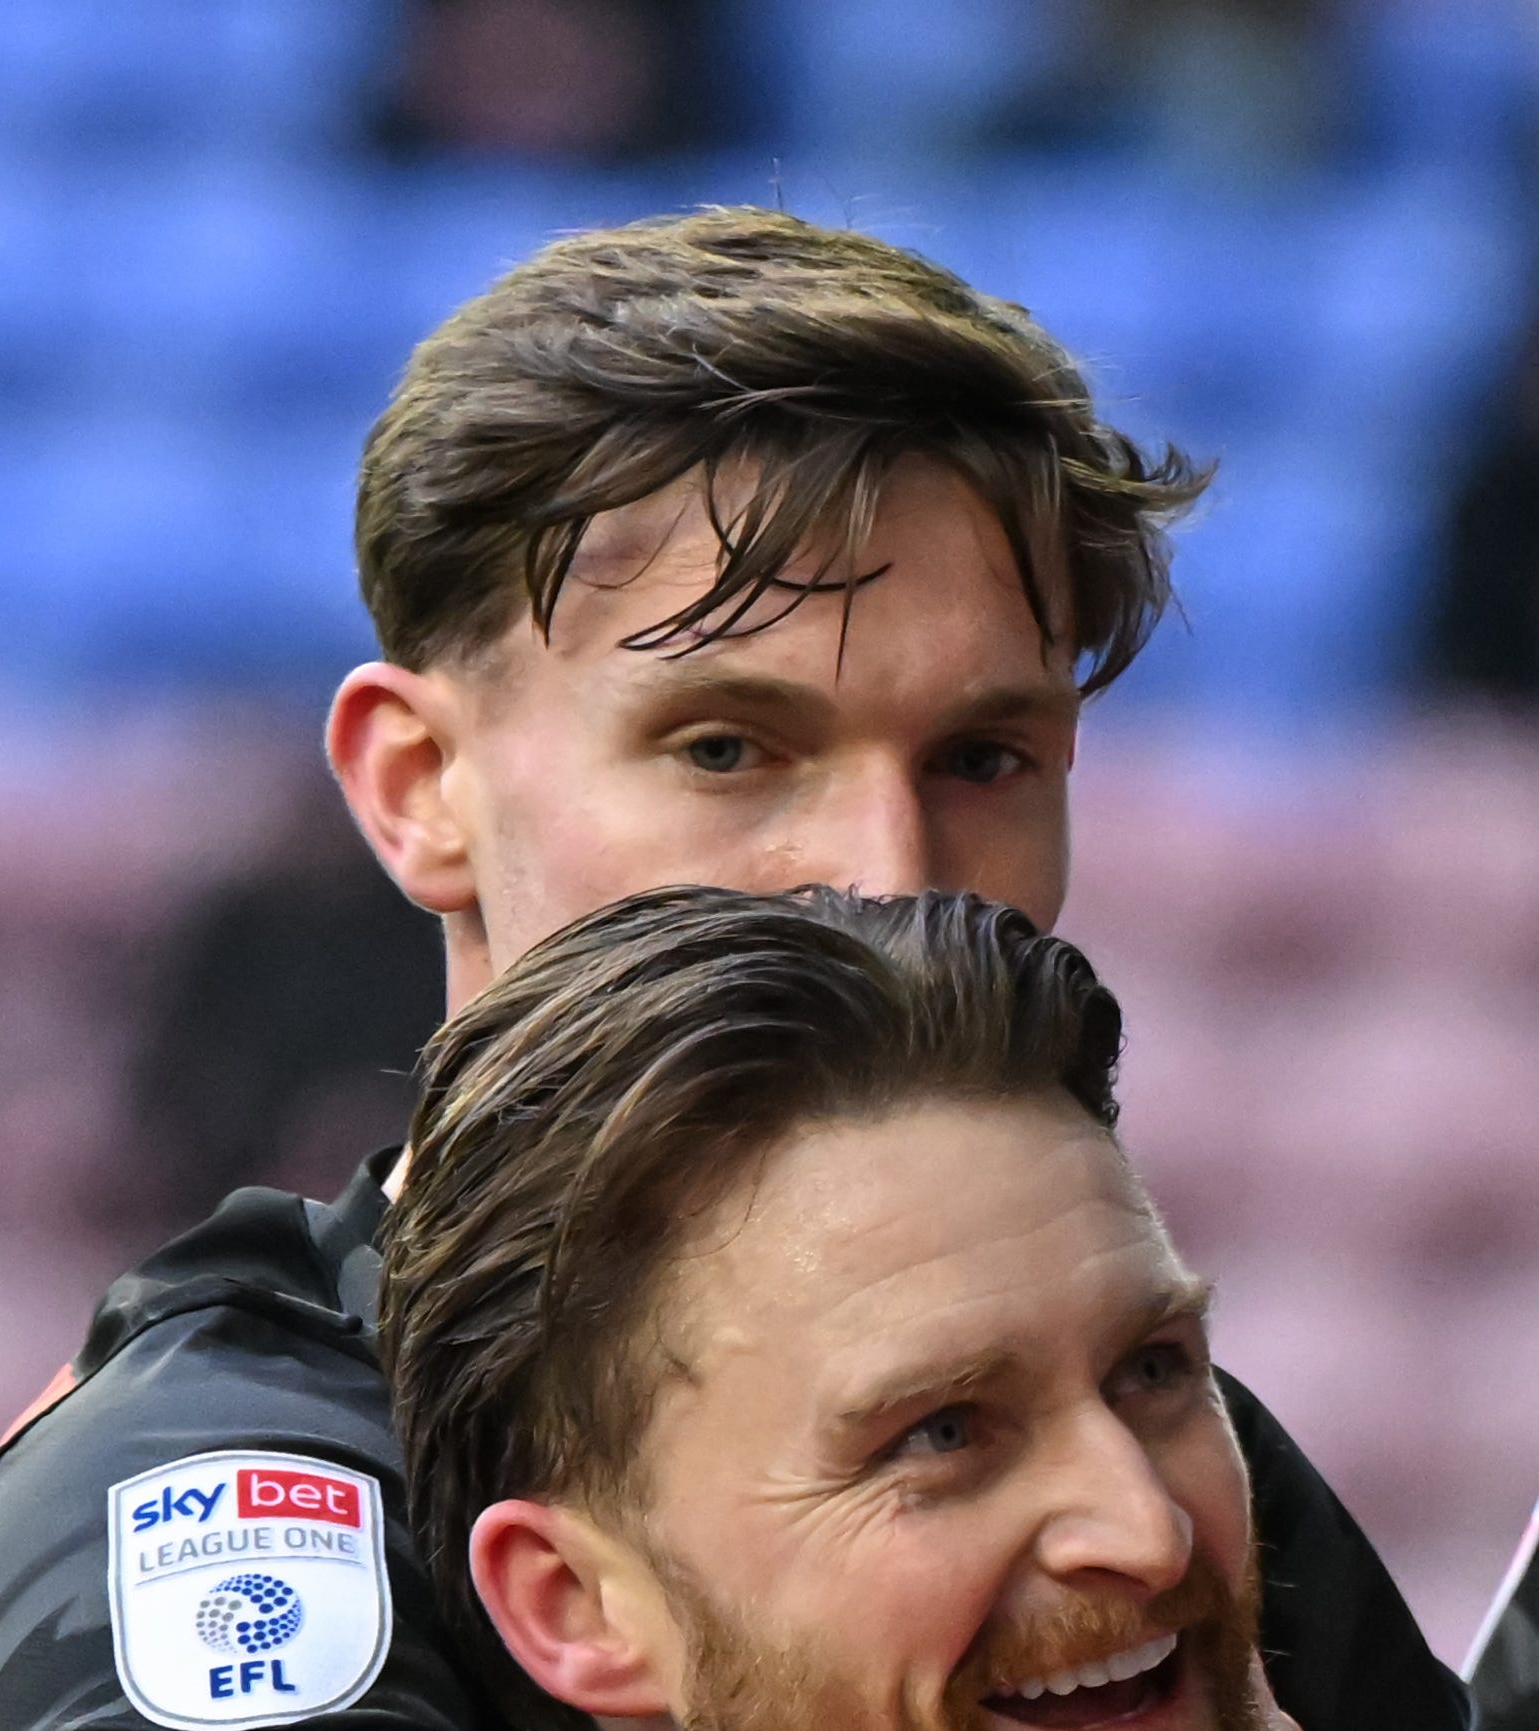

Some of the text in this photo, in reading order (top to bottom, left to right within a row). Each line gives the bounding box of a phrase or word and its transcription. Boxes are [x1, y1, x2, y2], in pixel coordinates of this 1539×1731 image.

[132, 1473, 349, 1533] sky bet
[139, 1526, 356, 1573] LEAGUE ONE
[209, 1659, 296, 1700] EFL
